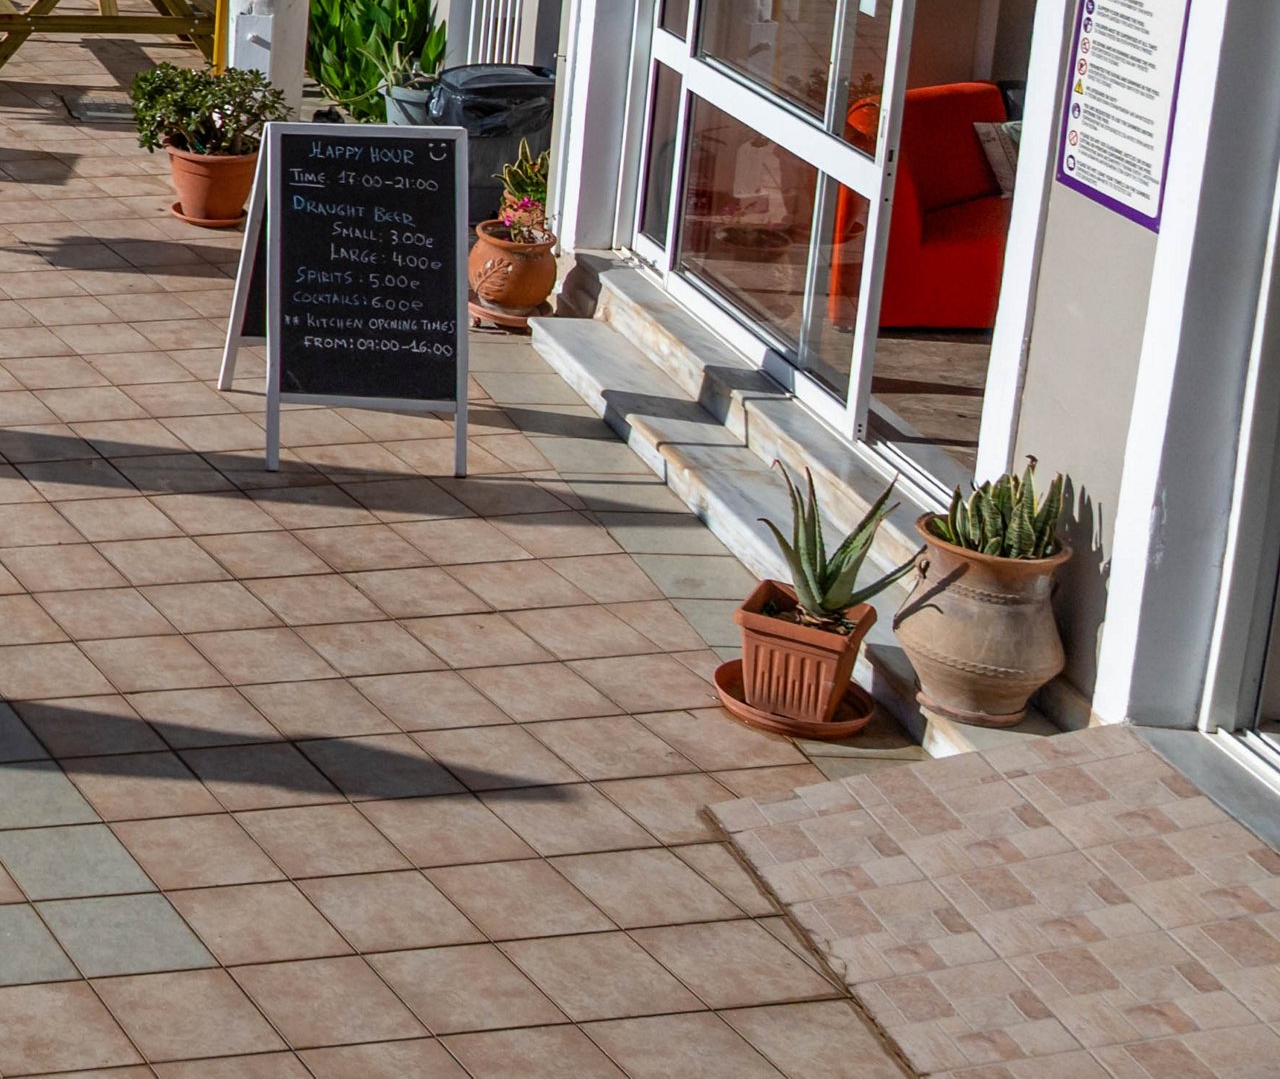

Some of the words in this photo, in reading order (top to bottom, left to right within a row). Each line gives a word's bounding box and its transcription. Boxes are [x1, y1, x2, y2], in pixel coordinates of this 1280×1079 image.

[309, 141, 363, 160] HAPPY
[371, 146, 414, 165] HOUR
[292, 195, 365, 217] DRAUGHT
[374, 208, 416, 227] BEER
[307, 313, 363, 329] KITCHEN
[368, 318, 417, 330] OPENING
[420, 319, 456, 333] TIMES
